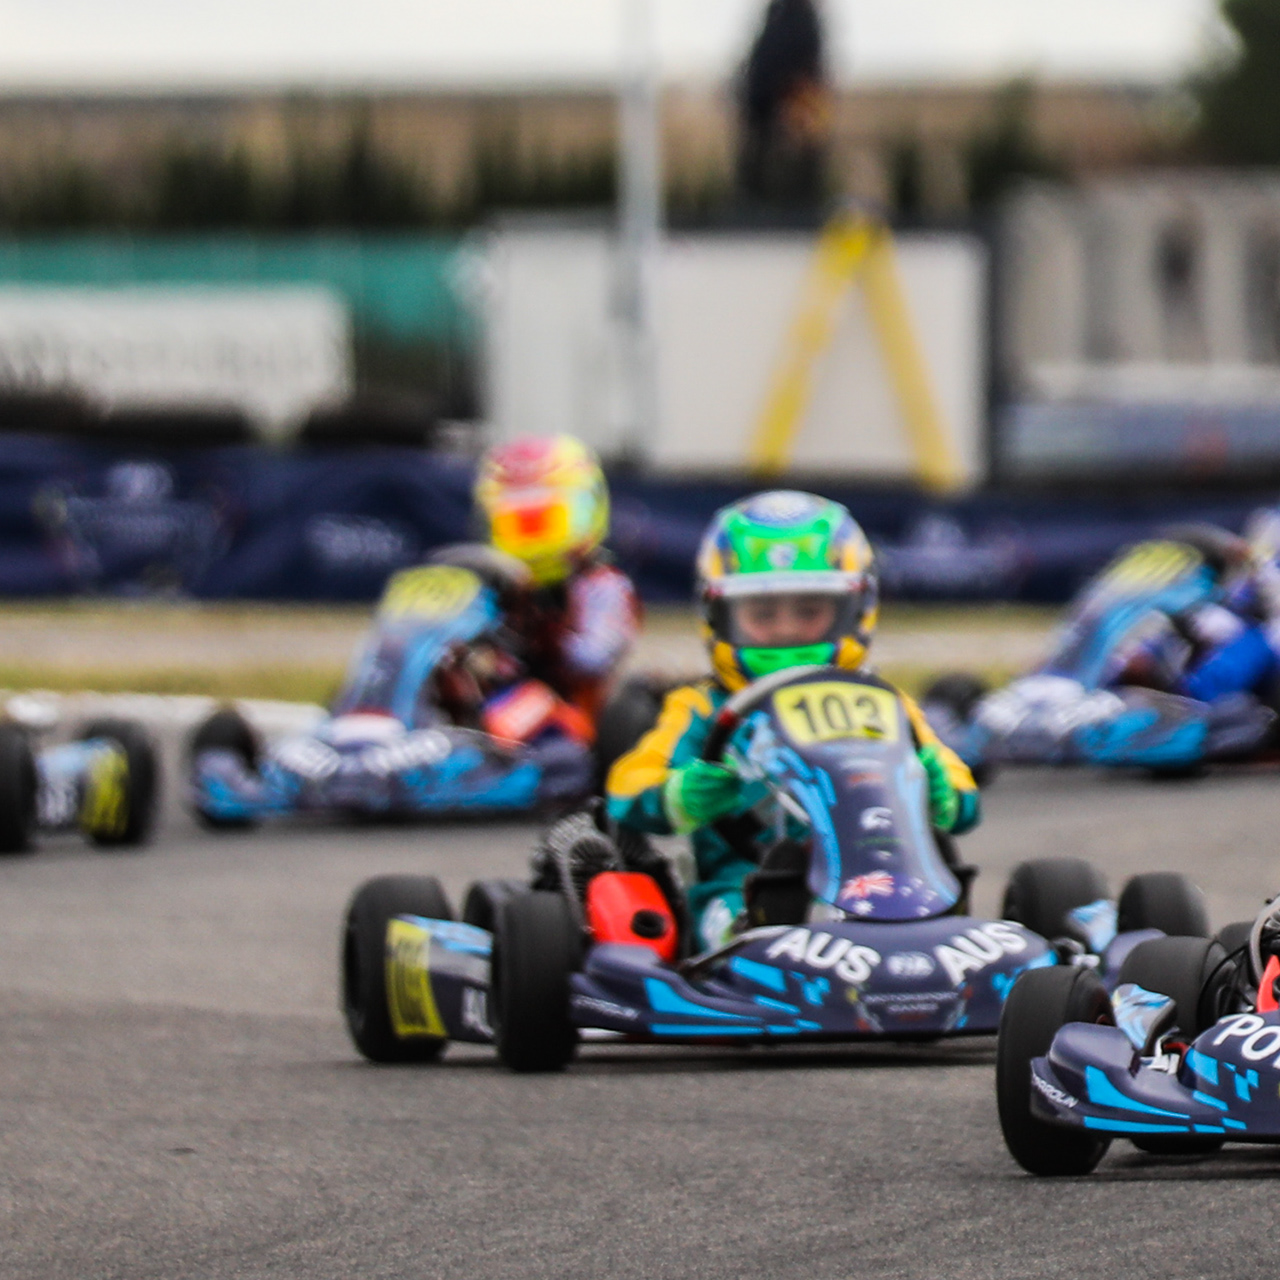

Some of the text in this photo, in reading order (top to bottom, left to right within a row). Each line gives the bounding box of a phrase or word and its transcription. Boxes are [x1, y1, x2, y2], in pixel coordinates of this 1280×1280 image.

[792, 694, 880, 737] 103
[766, 927, 882, 985] AUS
[933, 921, 1027, 986] AUS
